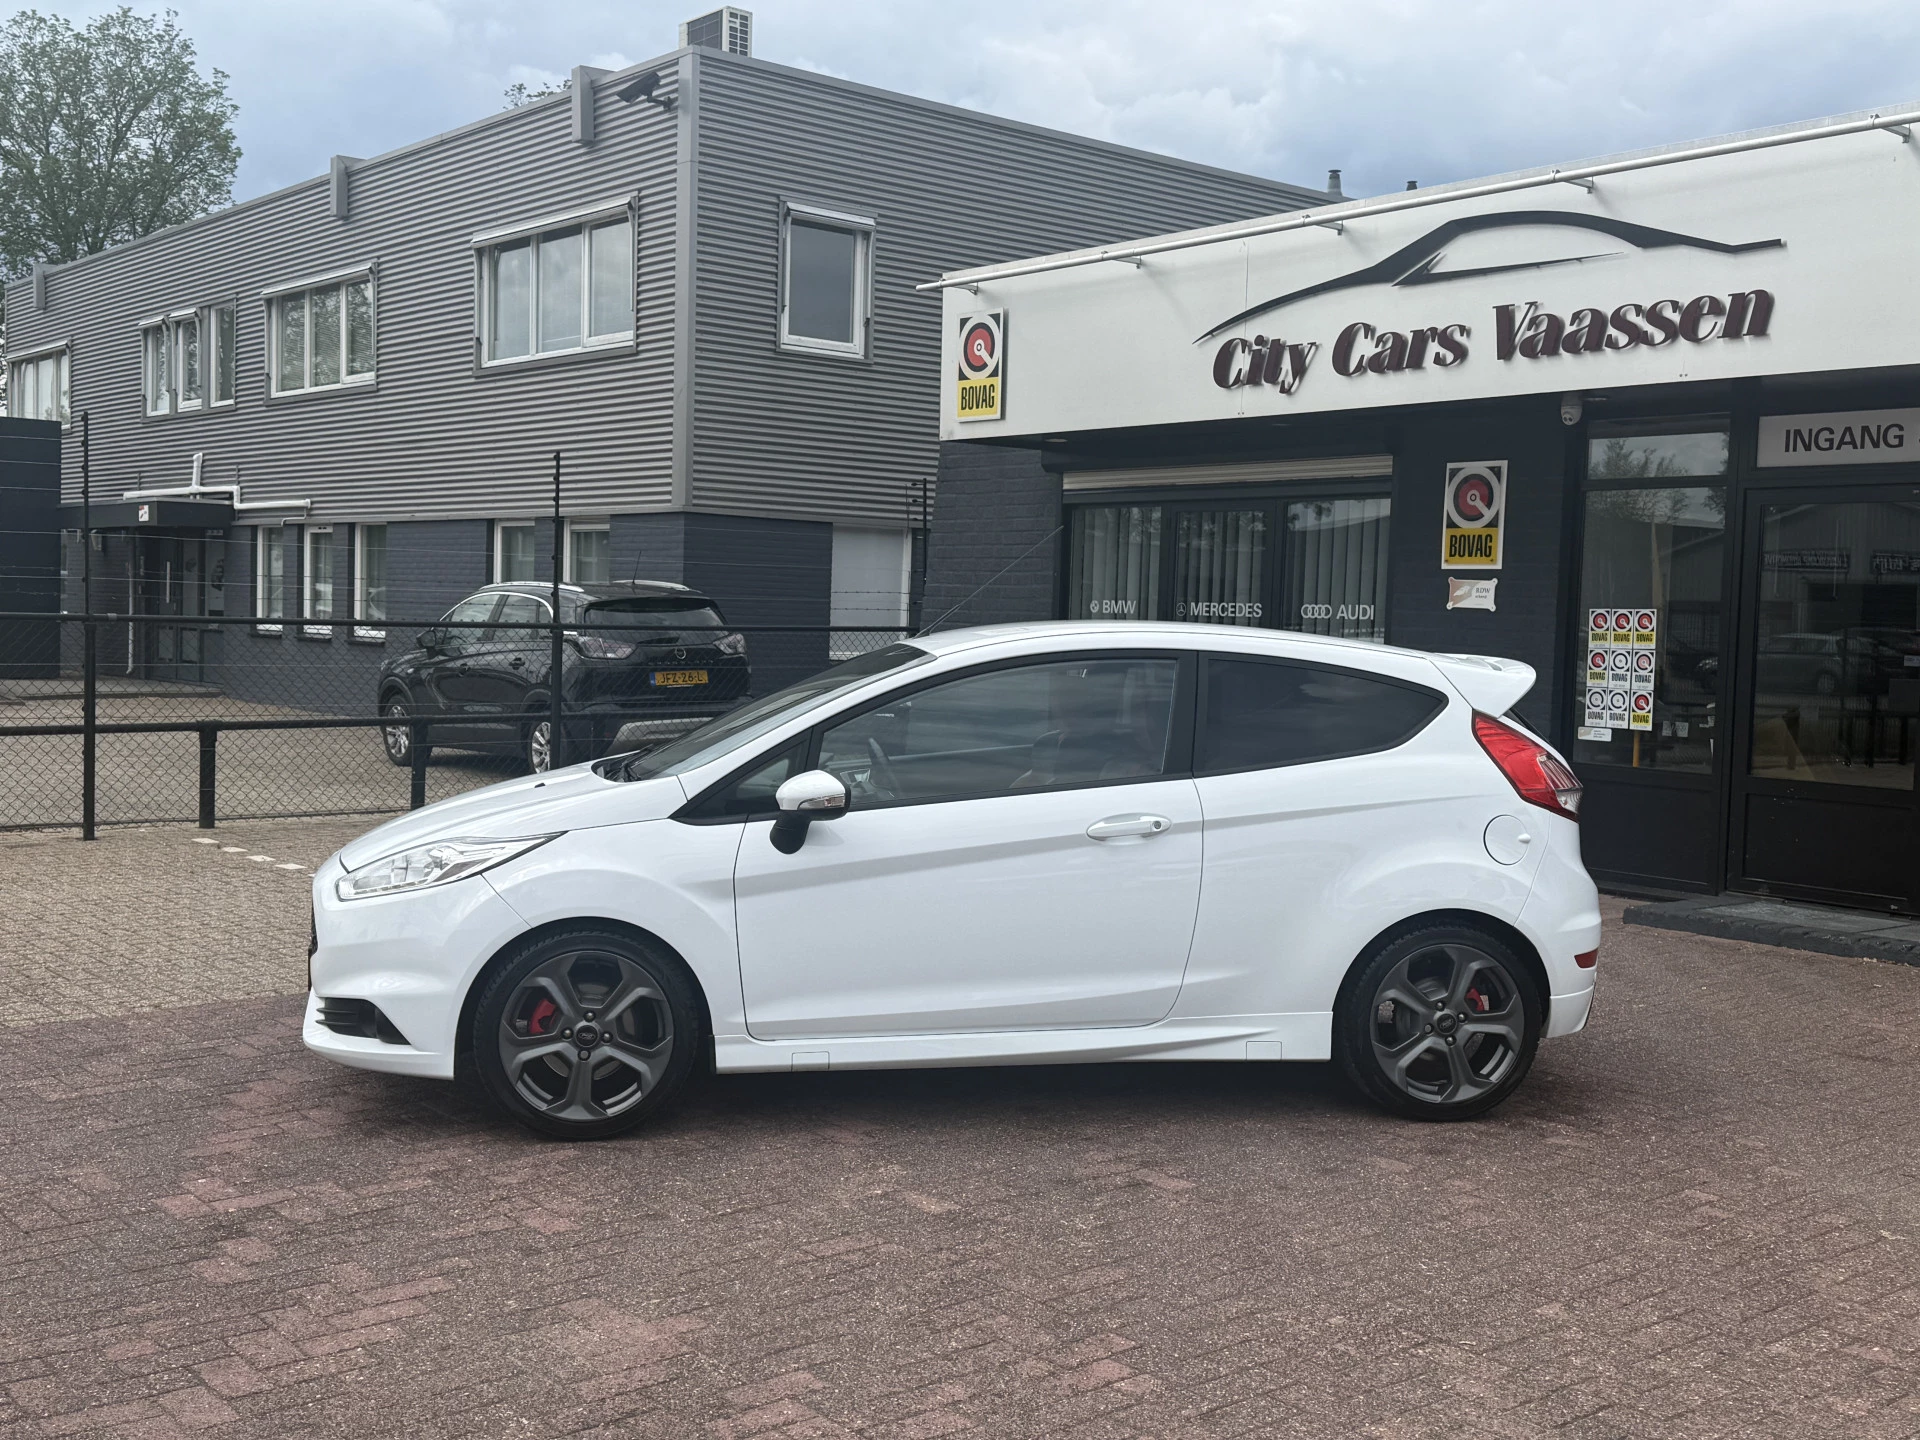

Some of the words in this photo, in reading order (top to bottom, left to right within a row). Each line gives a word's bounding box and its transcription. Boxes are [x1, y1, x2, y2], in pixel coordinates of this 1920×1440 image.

[1212, 335, 1318, 394] City
[1332, 322, 1471, 376] Cars
[1492, 289, 1774, 361] Vaassen
[961, 384, 995, 410] BOVAG
[1784, 423, 1905, 453] INGANG
[1449, 534, 1493, 558] BOVAG
[1102, 600, 1137, 614] BMW
[1190, 602, 1263, 618] MERCEDES
[1336, 604, 1375, 620] AUDI
[1613, 633, 1631, 642] BOVAG
[661, 671, 704, 684] JFZ-26-L
[1589, 672, 1606, 681] BOVAG
[1611, 673, 1628, 682] BOVAG
[1634, 674, 1652, 684] BOVAG
[1587, 711, 1604, 721] BOVAG
[1609, 712, 1626, 722] BOVAG
[1632, 714, 1650, 724] BOVAG
